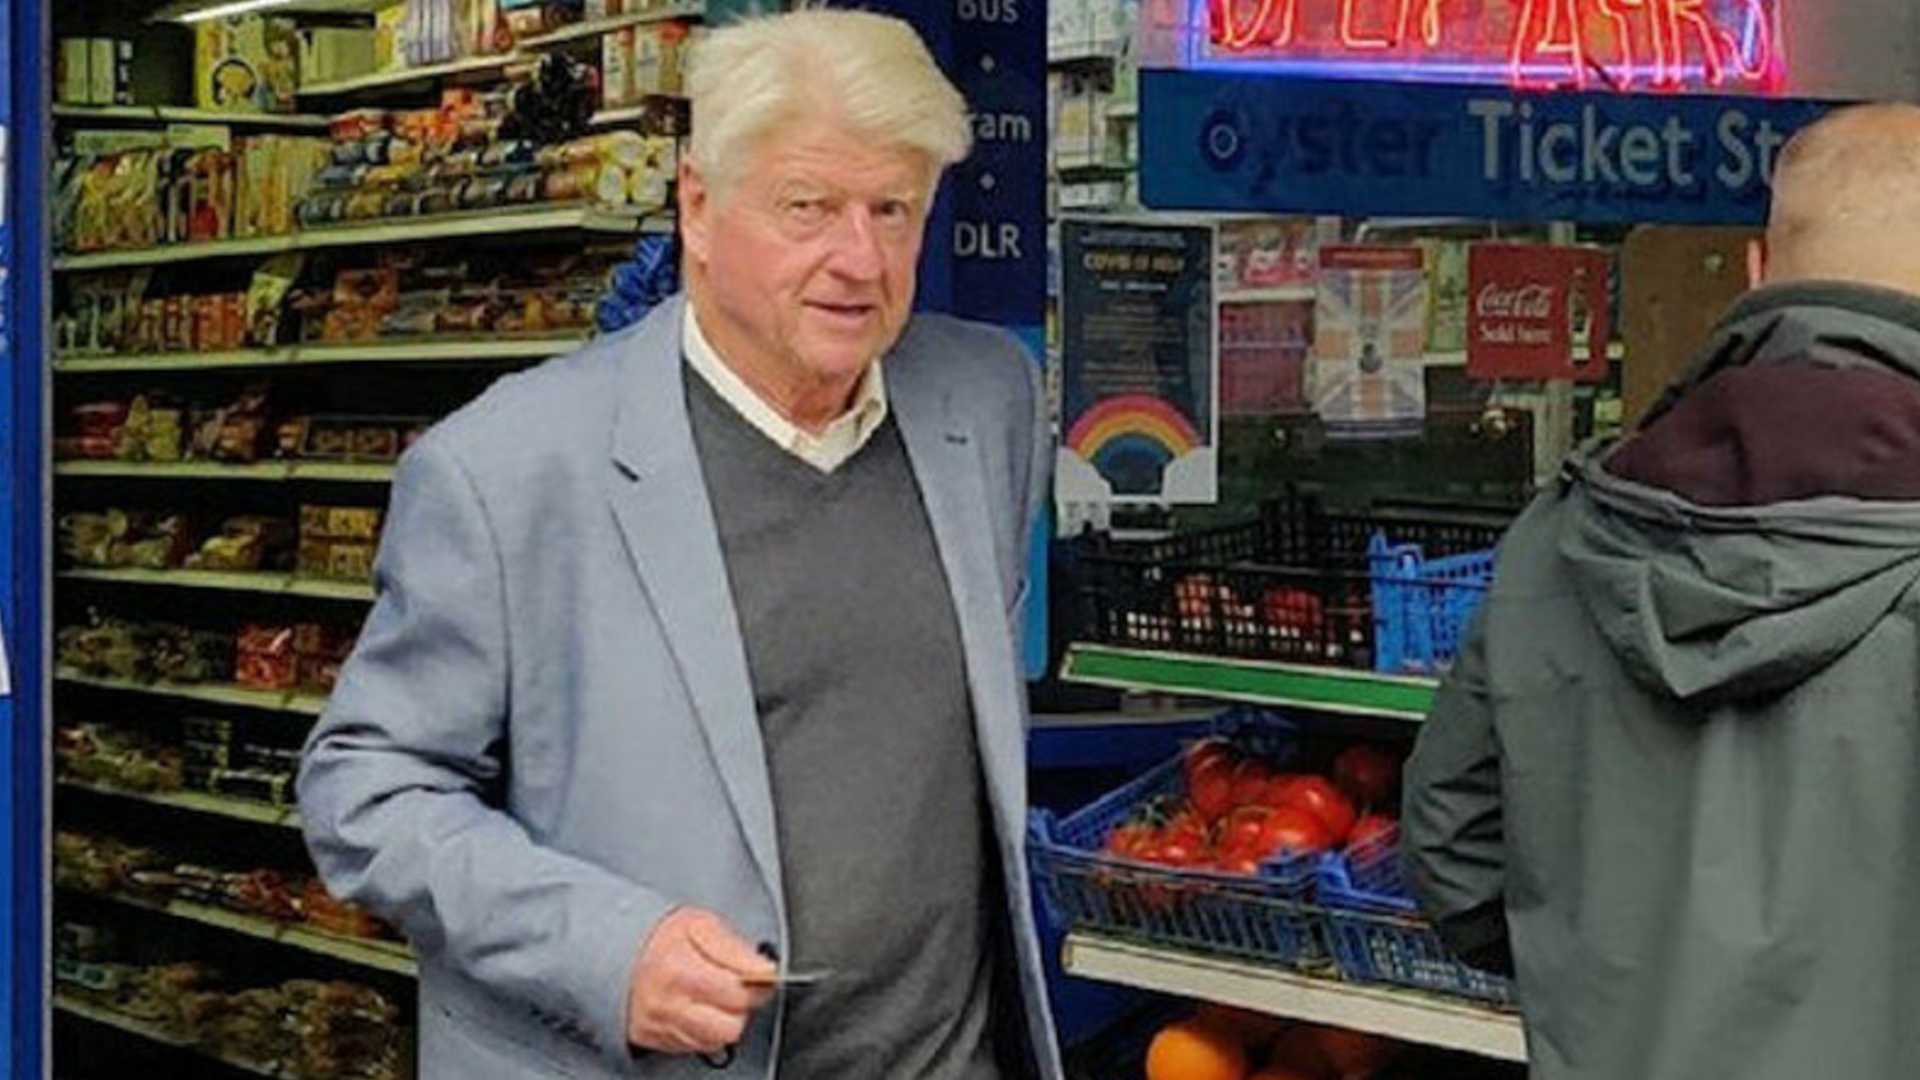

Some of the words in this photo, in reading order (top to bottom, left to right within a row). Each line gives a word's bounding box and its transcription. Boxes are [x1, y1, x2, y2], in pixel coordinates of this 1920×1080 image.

[966, 111, 1032, 141] ram
[1466, 98, 1694, 185] Ticket
[1715, 108, 1782, 185] St
[953, 222, 1022, 258] DLR
